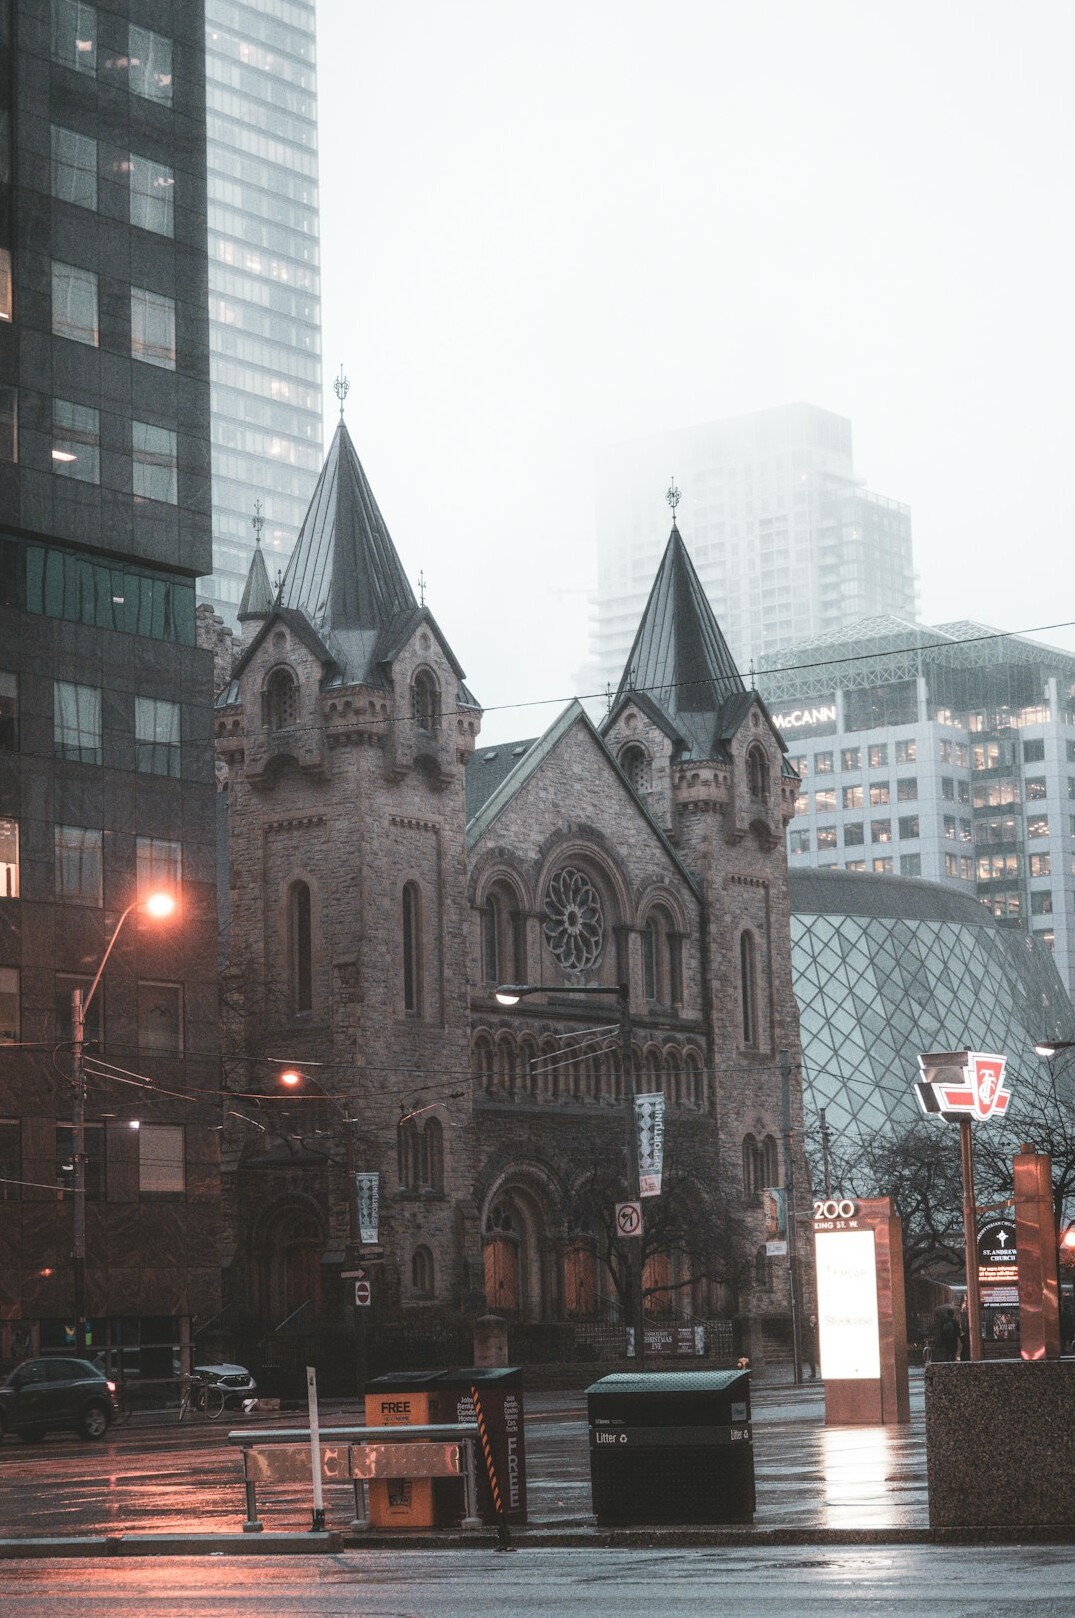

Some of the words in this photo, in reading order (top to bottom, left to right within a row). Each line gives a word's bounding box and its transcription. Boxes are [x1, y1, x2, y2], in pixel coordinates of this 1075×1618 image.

[772, 706, 836, 729] McCANN
[654, 1097, 664, 1170] OPPORTUNITY
[814, 1200, 854, 1219] 200
[849, 1220, 858, 1228] W.
[381, 1402, 411, 1413] FREE
[596, 1432, 616, 1443] Litter
[730, 1429, 742, 1441] Litter
[507, 1437, 520, 1508] FREE
